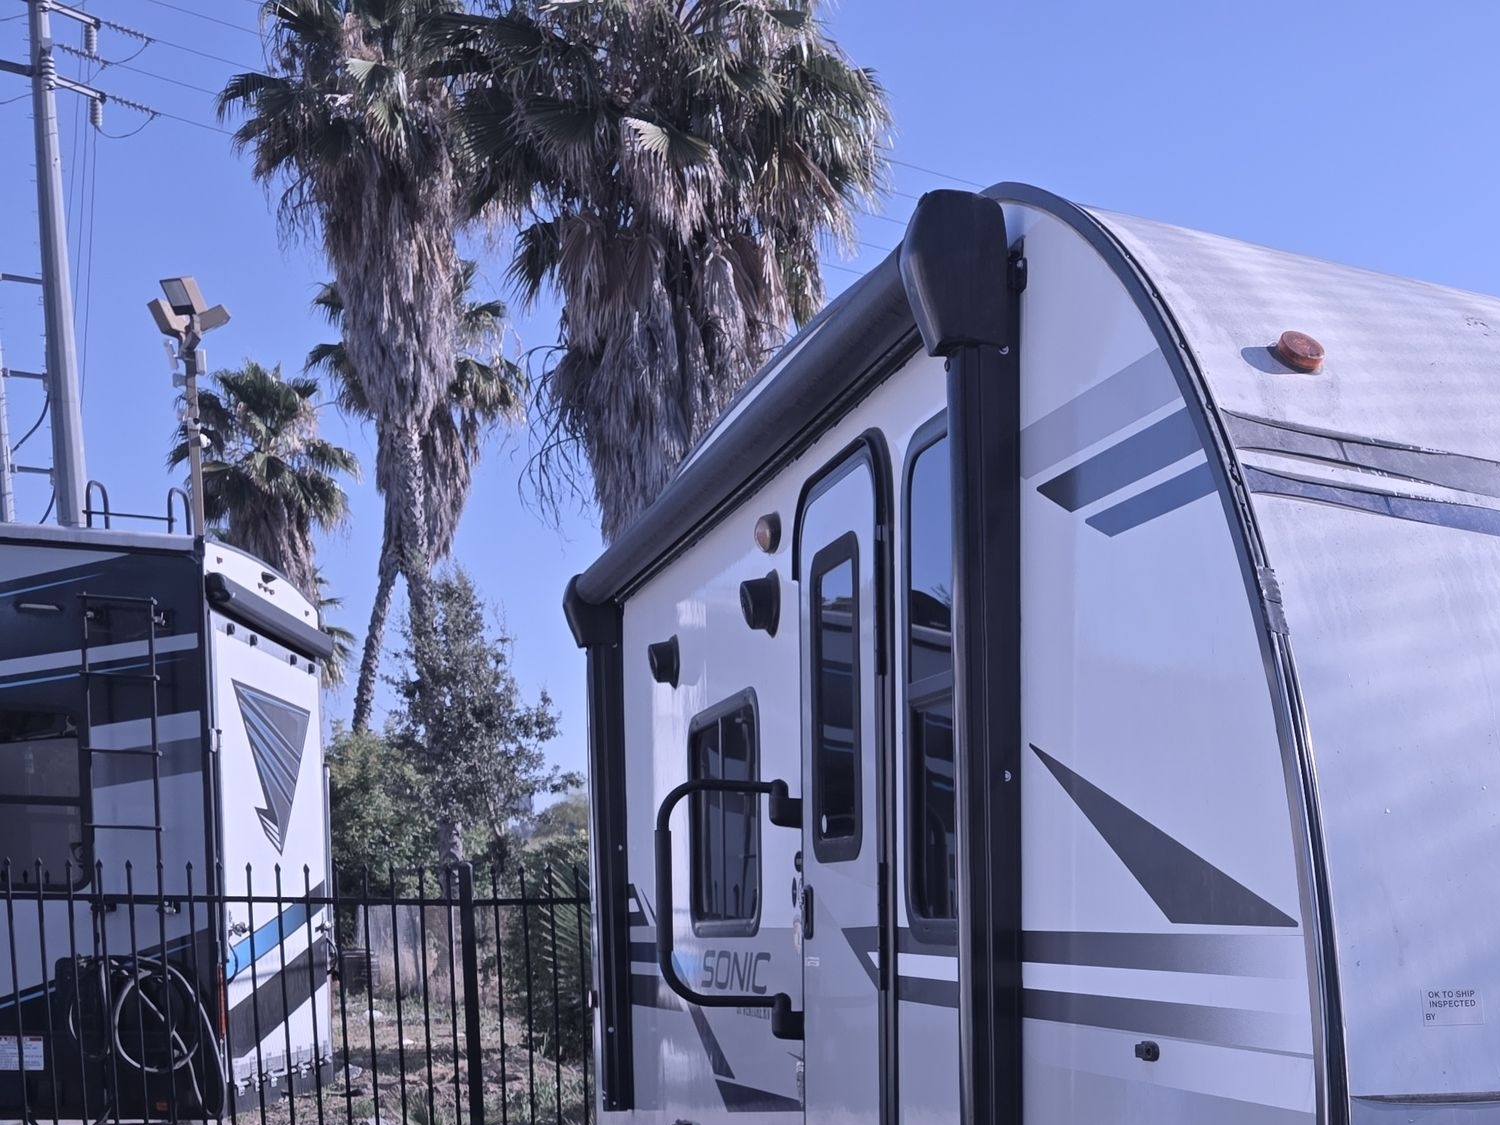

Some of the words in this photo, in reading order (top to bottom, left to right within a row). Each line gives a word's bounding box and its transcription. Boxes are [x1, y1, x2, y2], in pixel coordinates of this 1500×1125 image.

[701, 950, 771, 994] SONIC
[1442, 990, 1454, 998] TO
[1456, 990, 1475, 998] SHIP
[1429, 1000, 1476, 1008] INSPECTED
[1425, 1013, 1436, 1021] BY
